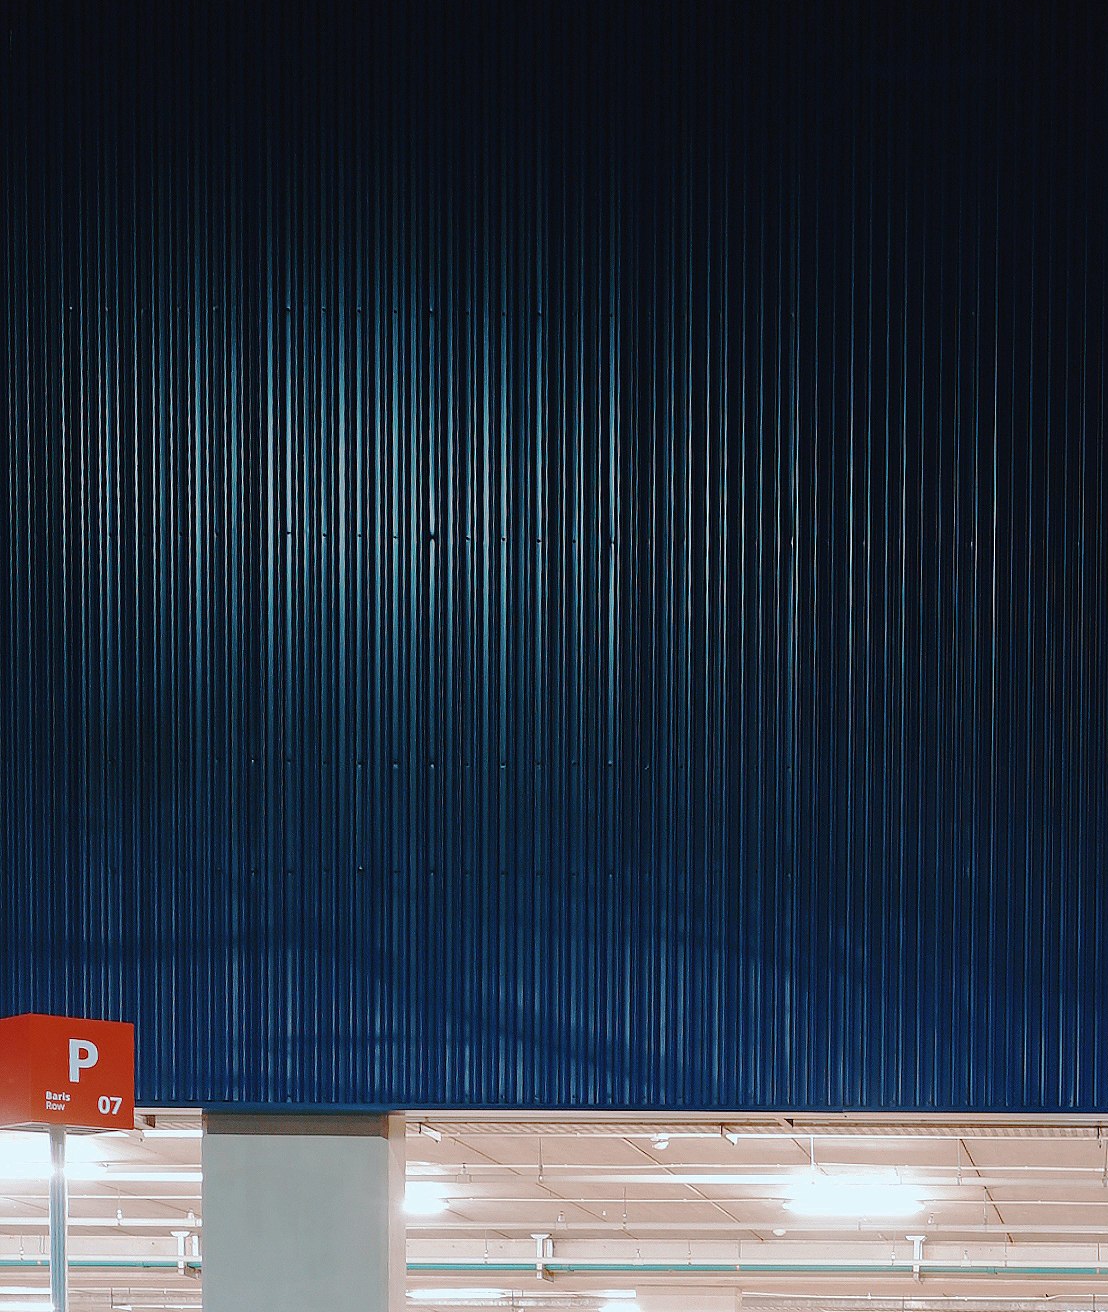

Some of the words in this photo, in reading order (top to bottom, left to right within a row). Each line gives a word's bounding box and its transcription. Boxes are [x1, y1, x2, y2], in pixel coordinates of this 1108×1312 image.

[69, 1038, 99, 1083] P
[46, 1100, 66, 1111] Row
[98, 1096, 122, 1115] 07
